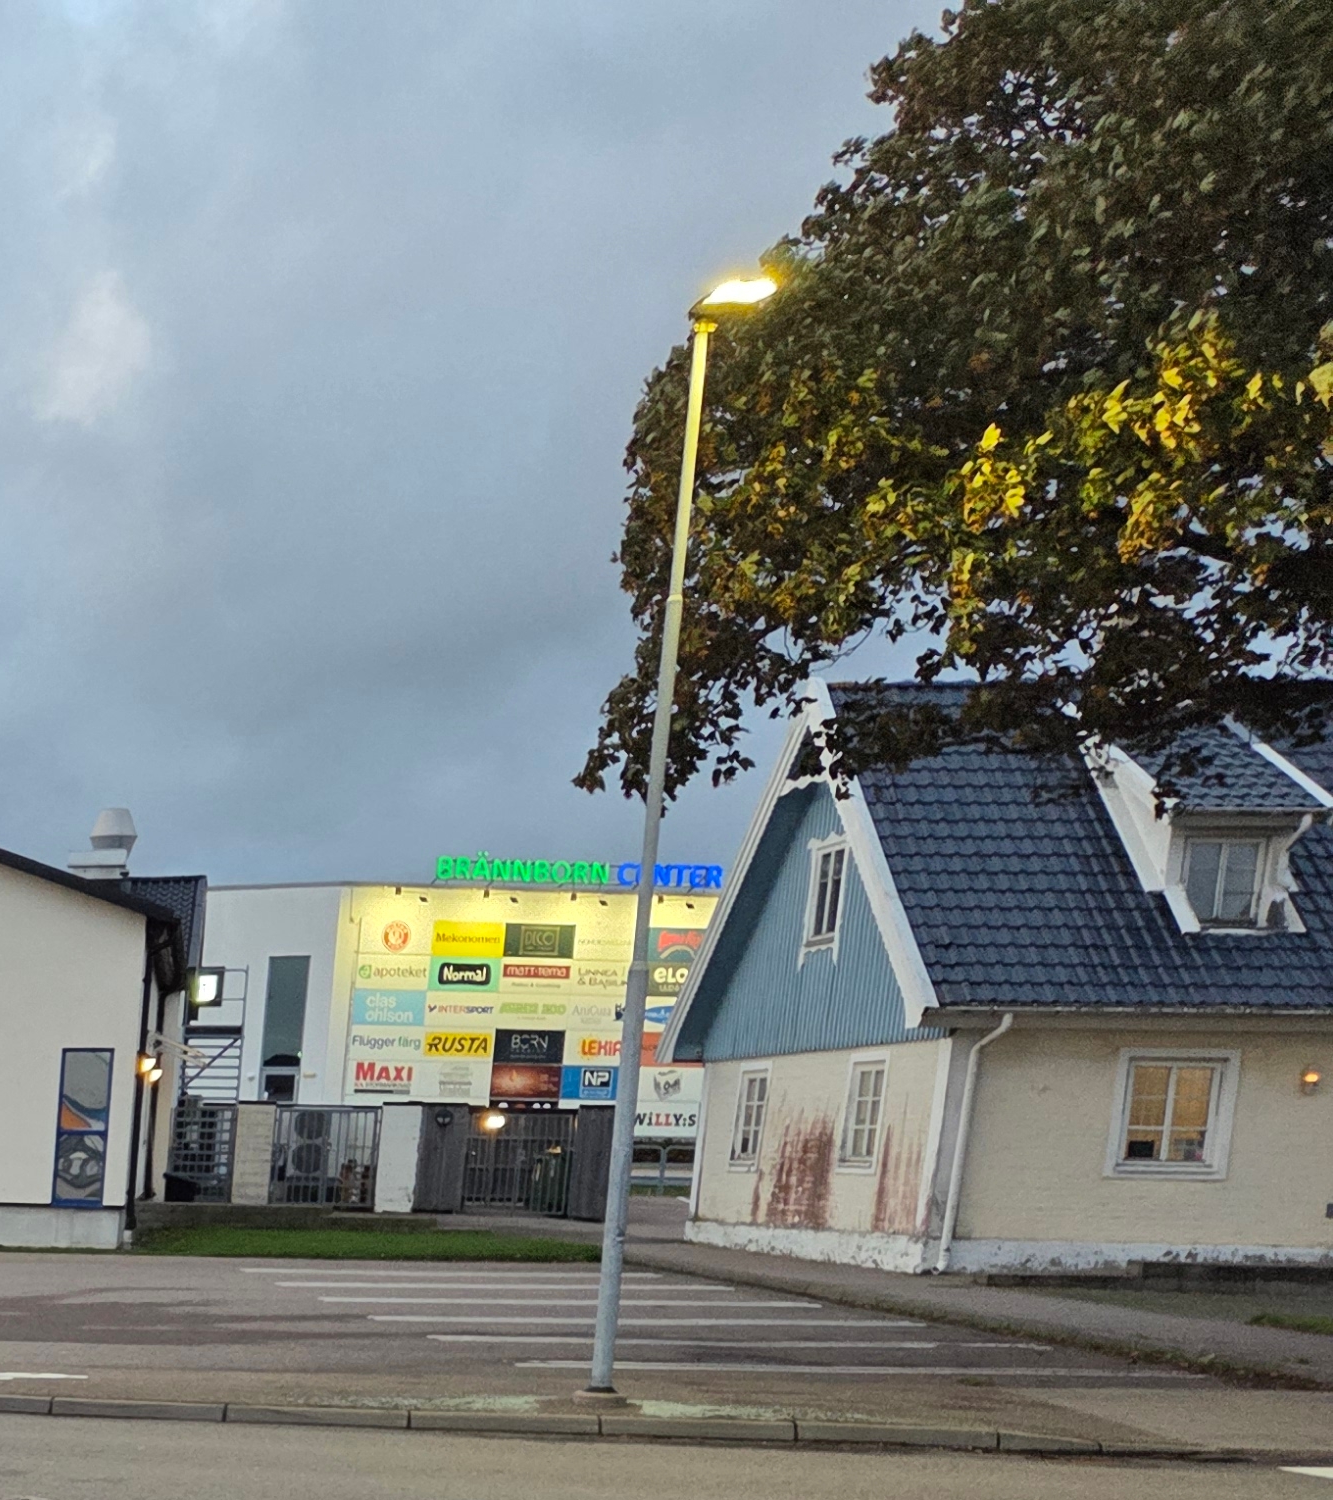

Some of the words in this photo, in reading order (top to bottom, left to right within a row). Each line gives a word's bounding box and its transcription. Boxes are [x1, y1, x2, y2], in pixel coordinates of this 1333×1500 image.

[436, 850, 610, 885] BRÄNNBORN
[617, 862, 724, 888] CNTER
[435, 932, 501, 944] Mekonomen
[373, 965, 427, 979] apoteket
[443, 965, 486, 982] Normal
[366, 992, 396, 1008] clas
[365, 1006, 413, 1022] ohlson
[438, 1005, 494, 1014] INTERSPORT
[352, 1035, 396, 1049] Flügger
[398, 1036, 421, 1049] färg
[428, 1037, 488, 1053] RUSTA
[355, 1062, 413, 1082] MAXI
[584, 1070, 610, 1086] NP
